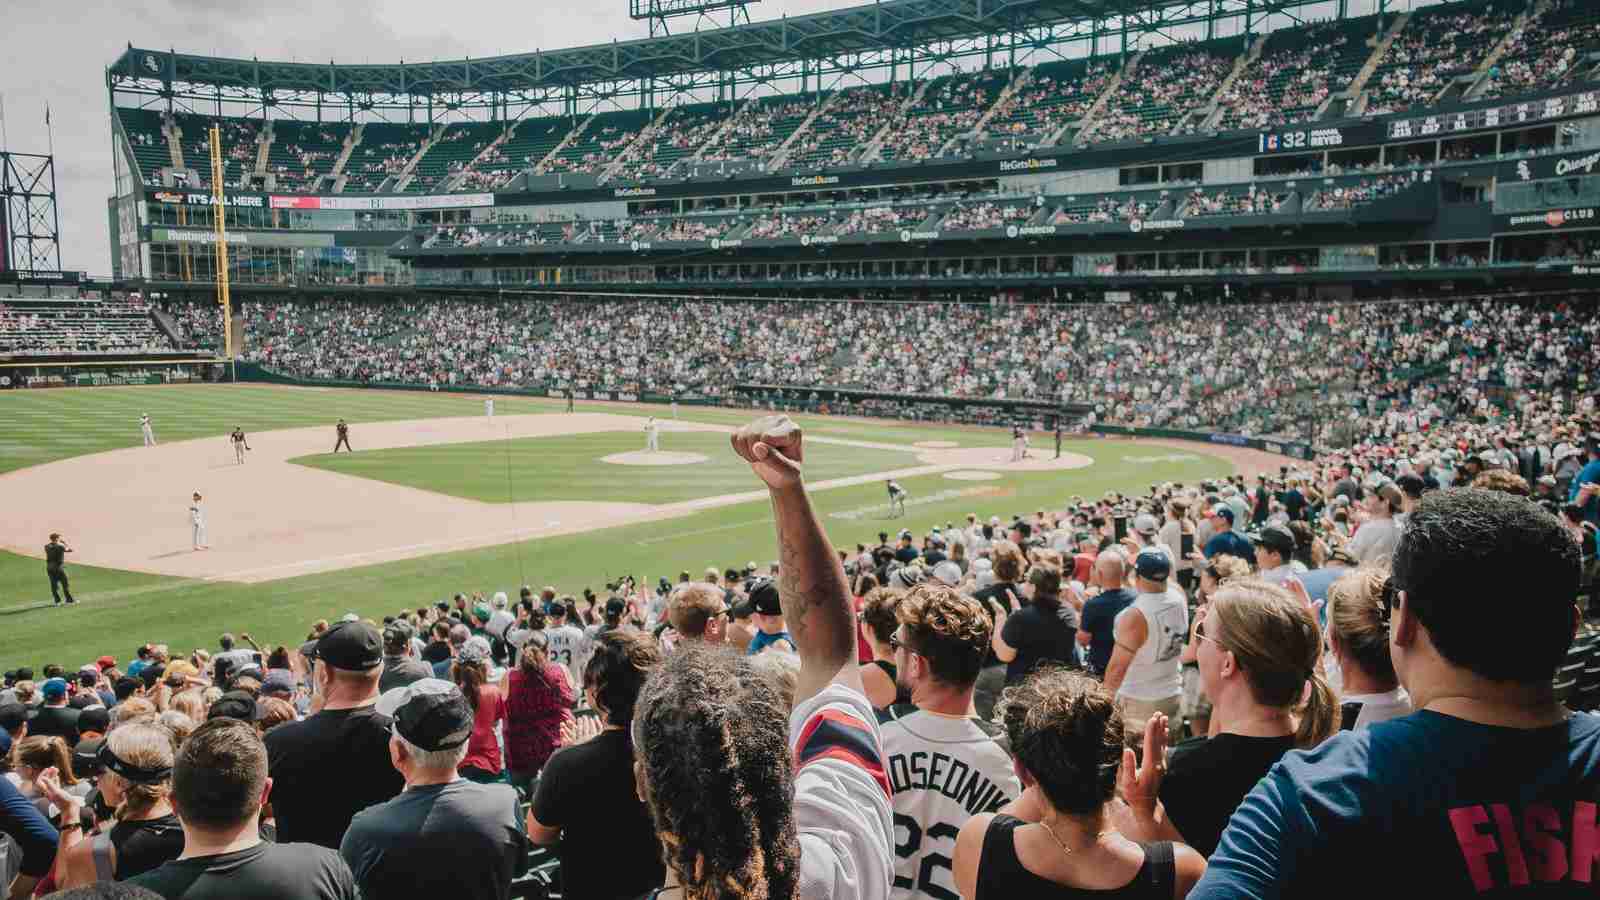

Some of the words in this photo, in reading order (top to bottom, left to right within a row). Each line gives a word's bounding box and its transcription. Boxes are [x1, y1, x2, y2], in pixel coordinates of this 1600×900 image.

[1282, 131, 1306, 148] 32
[233, 195, 263, 207] HERE
[1564, 208, 1594, 220] CLUB
